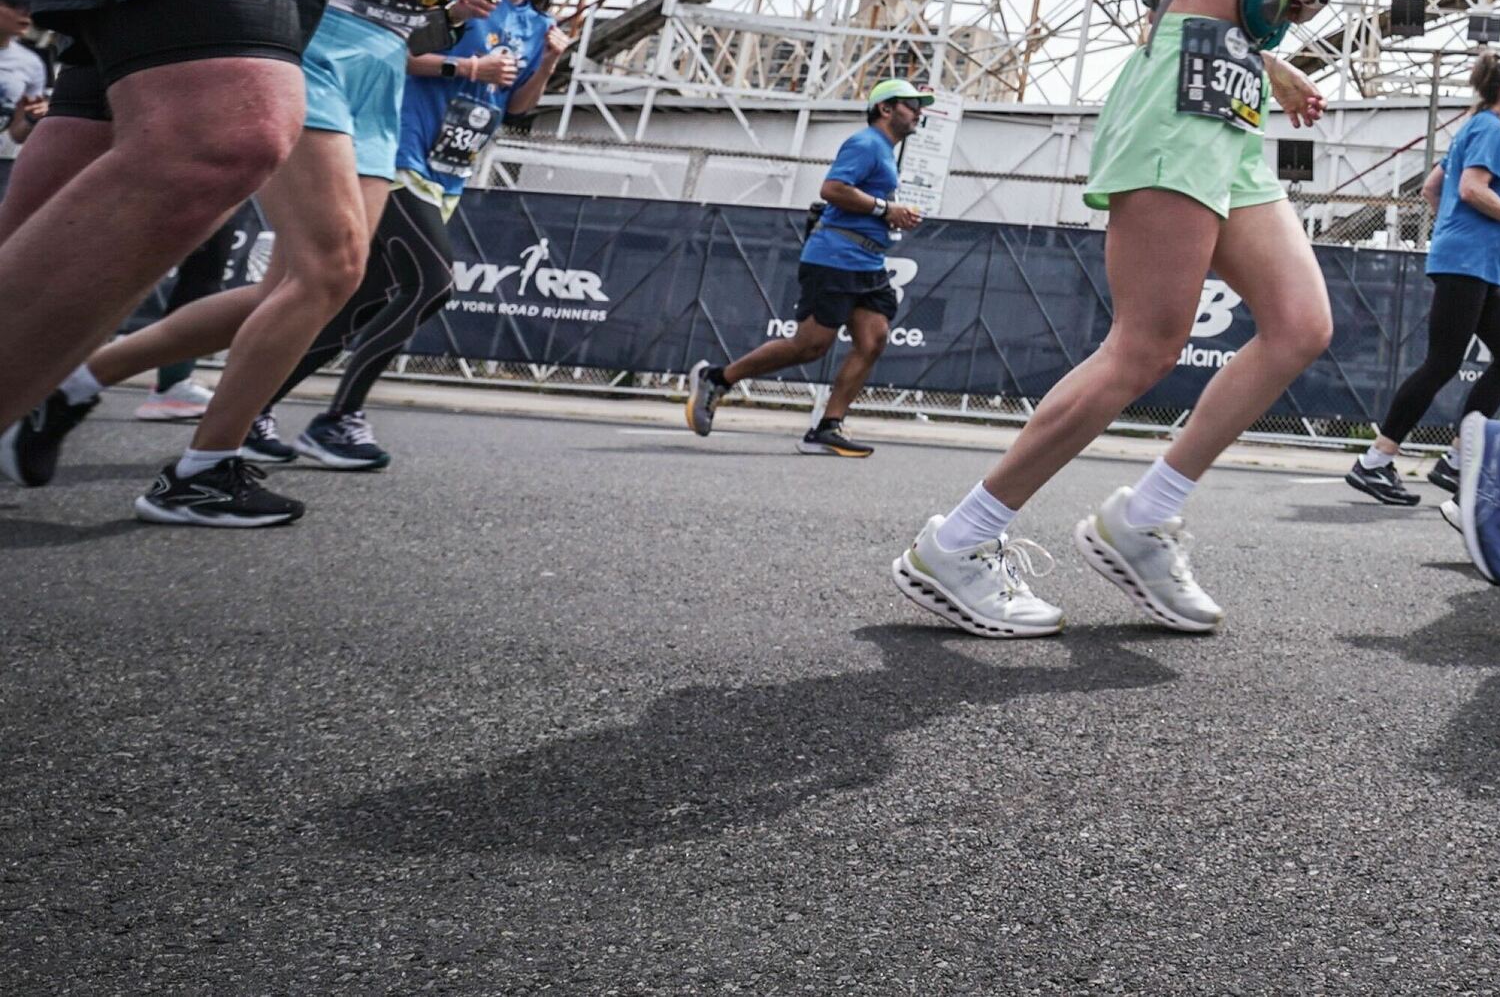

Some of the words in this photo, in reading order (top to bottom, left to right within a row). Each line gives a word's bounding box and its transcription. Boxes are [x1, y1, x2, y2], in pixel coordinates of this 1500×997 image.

[1210, 59, 1261, 110] 37786
[462, 301, 495, 314] YORK
[499, 303, 539, 317] ROAD
[542, 306, 608, 323] RUNNERS
[766, 318, 798, 339] ne
